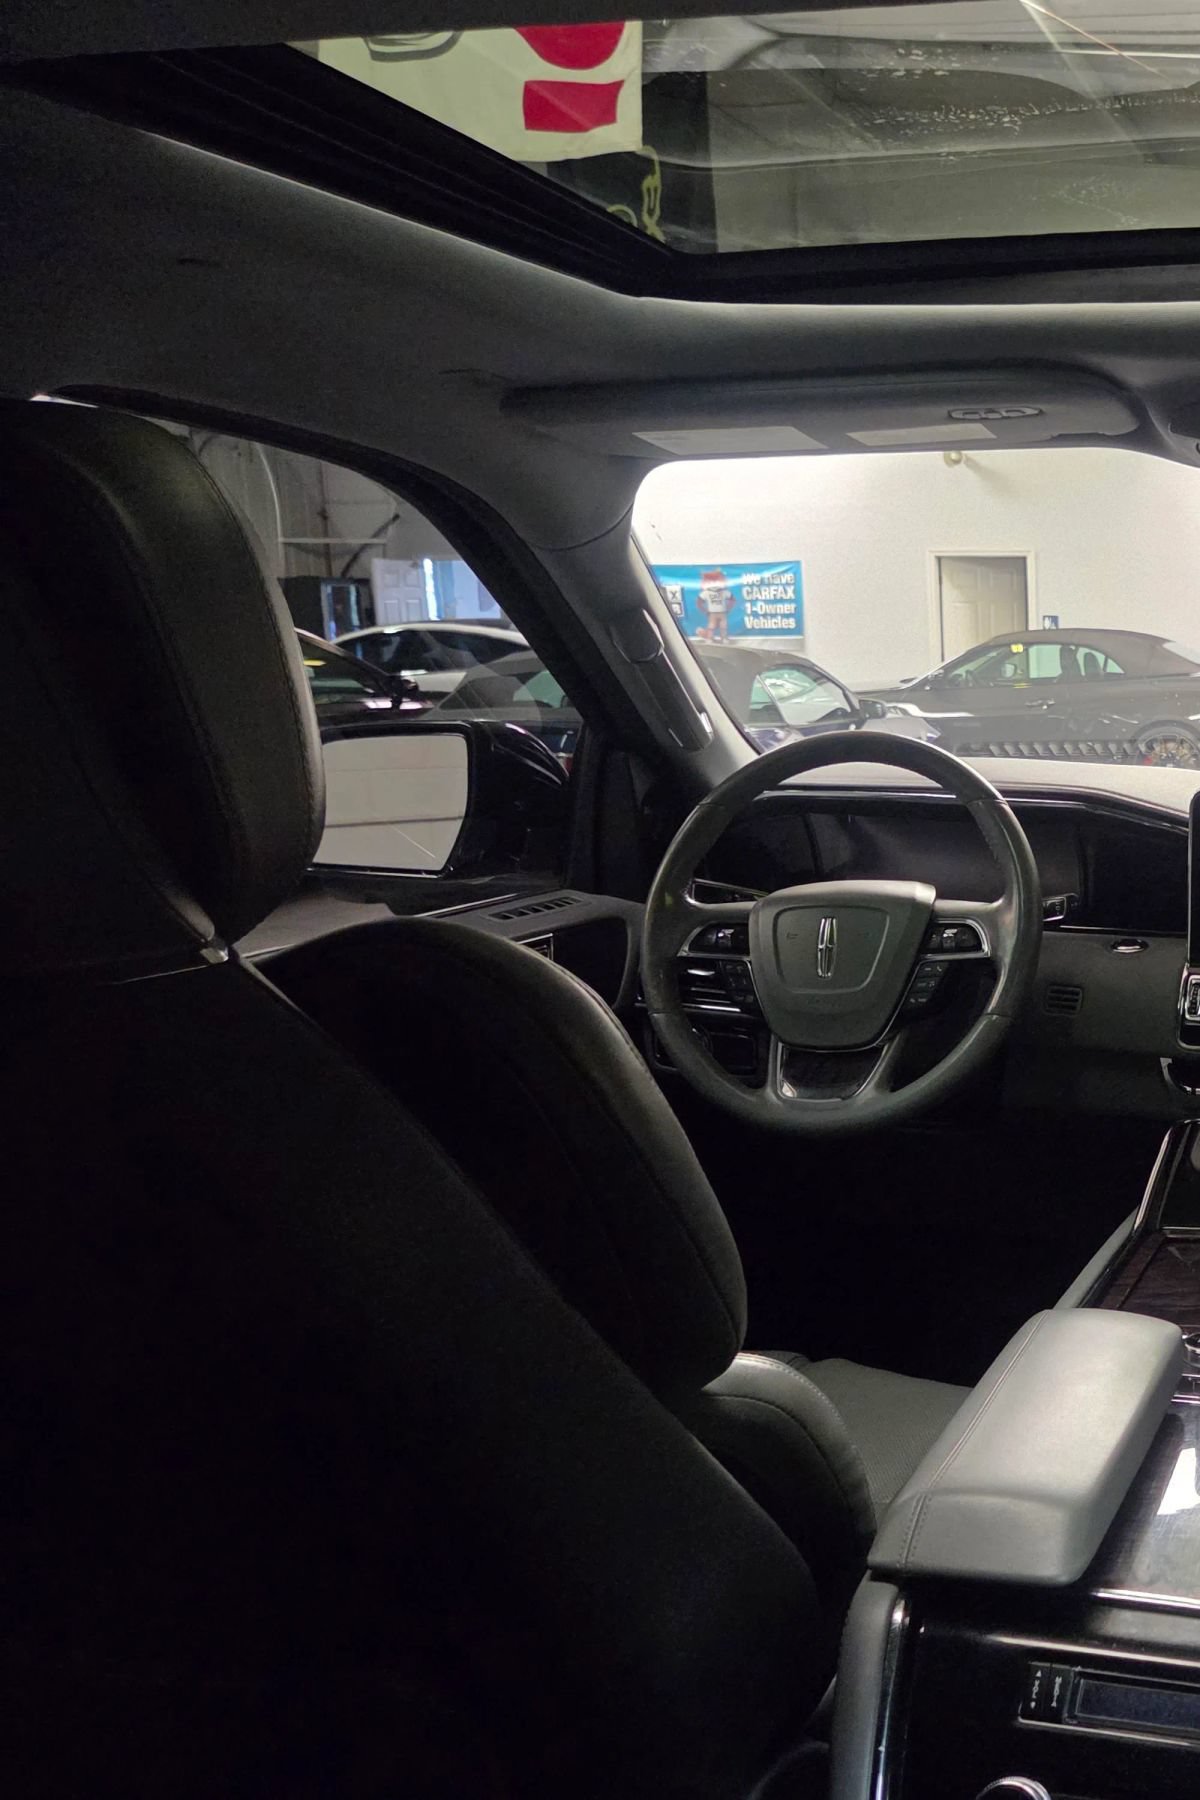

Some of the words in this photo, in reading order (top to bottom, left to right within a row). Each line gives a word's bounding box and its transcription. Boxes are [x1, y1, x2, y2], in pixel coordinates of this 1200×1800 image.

[742, 573, 760, 584] We
[764, 573, 795, 584] have
[742, 585, 795, 600] CARFAX
[745, 601, 796, 614] 1-Owner
[744, 616, 796, 629] Vehicles
